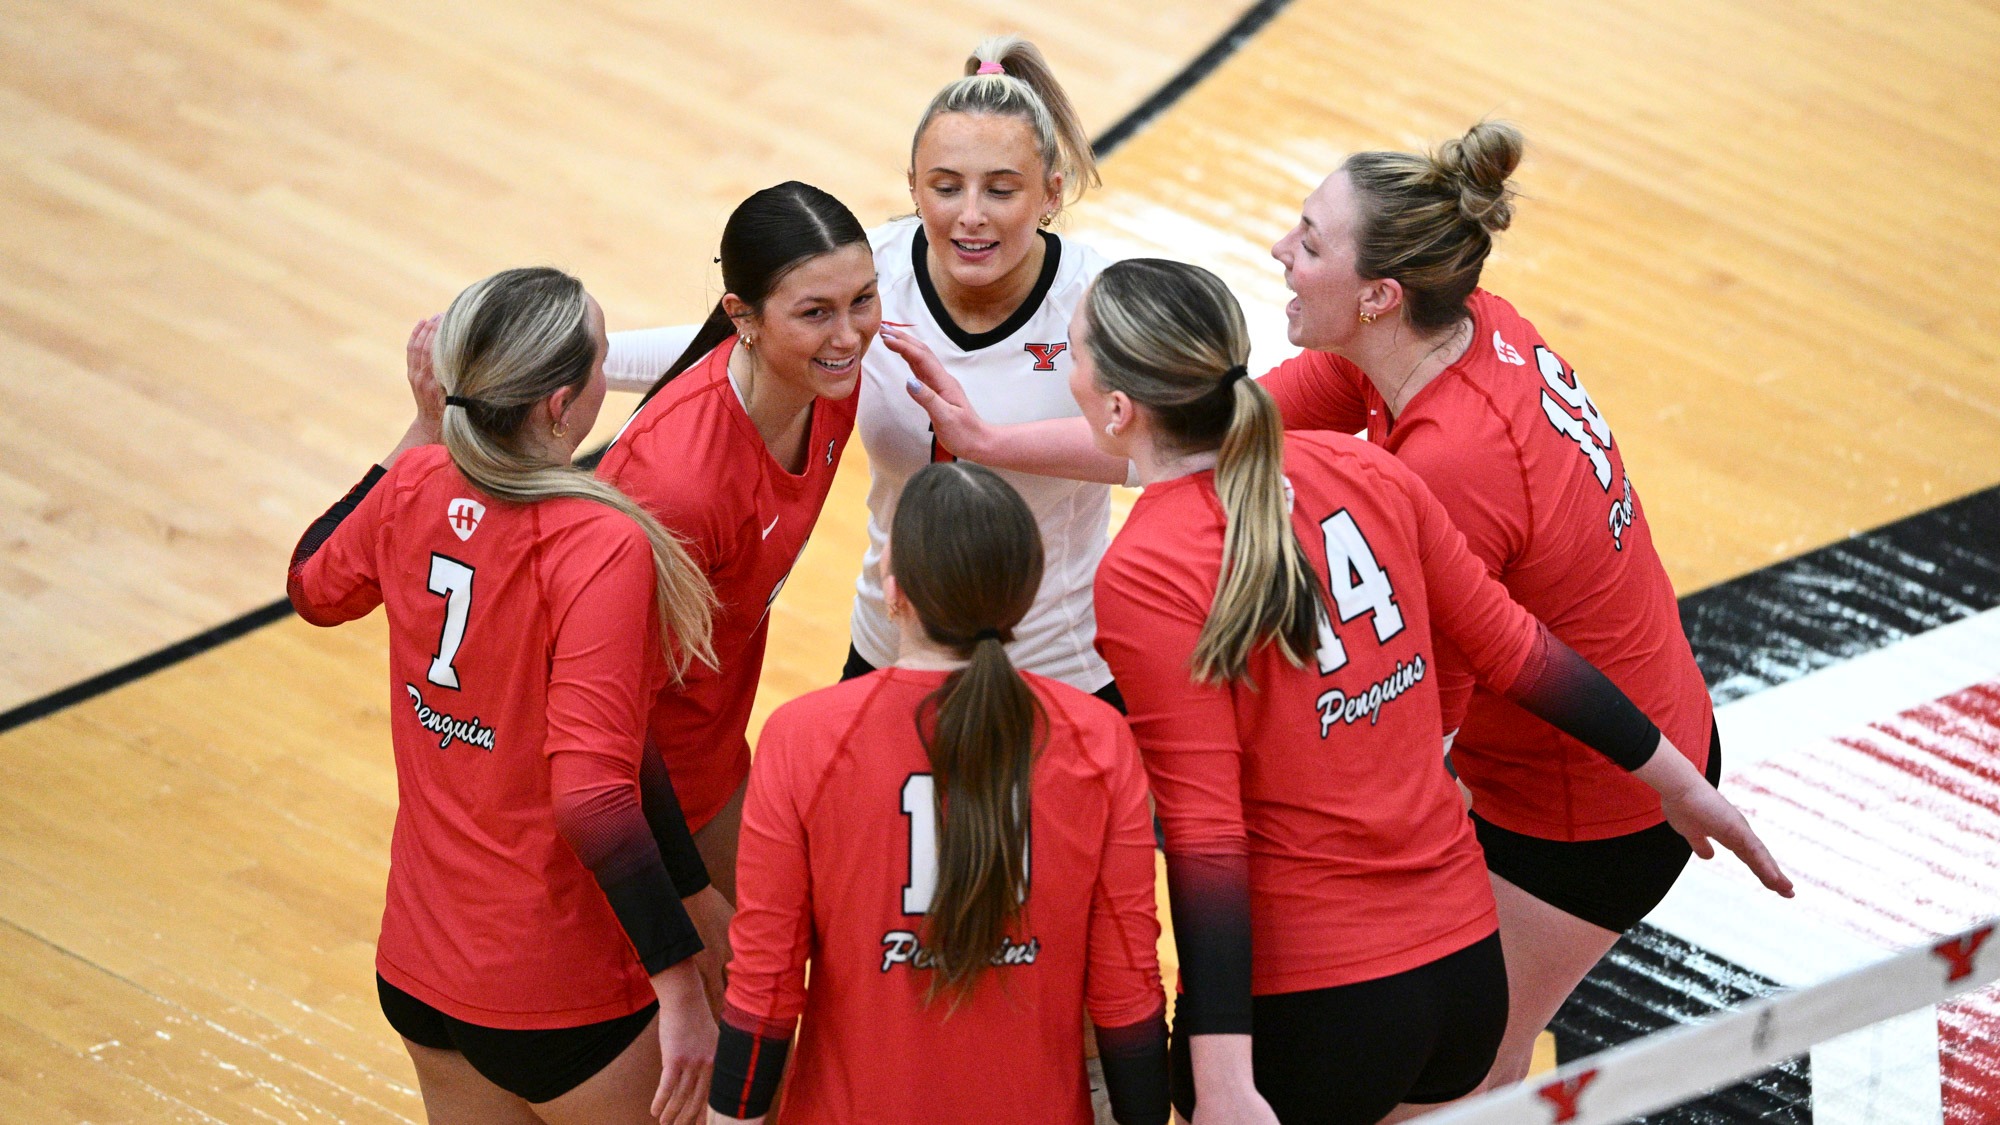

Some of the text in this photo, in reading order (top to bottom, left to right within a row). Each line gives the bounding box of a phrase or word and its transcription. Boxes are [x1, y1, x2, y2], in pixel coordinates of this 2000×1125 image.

[1024, 342, 1067, 371] Y
[427, 551, 476, 692] 7
[1316, 653, 1426, 739] Penguins
[900, 771, 1032, 916] 1
[880, 929, 1041, 973] Peins
[1934, 924, 1995, 984] Y
[1537, 1068, 1601, 1124] Y
